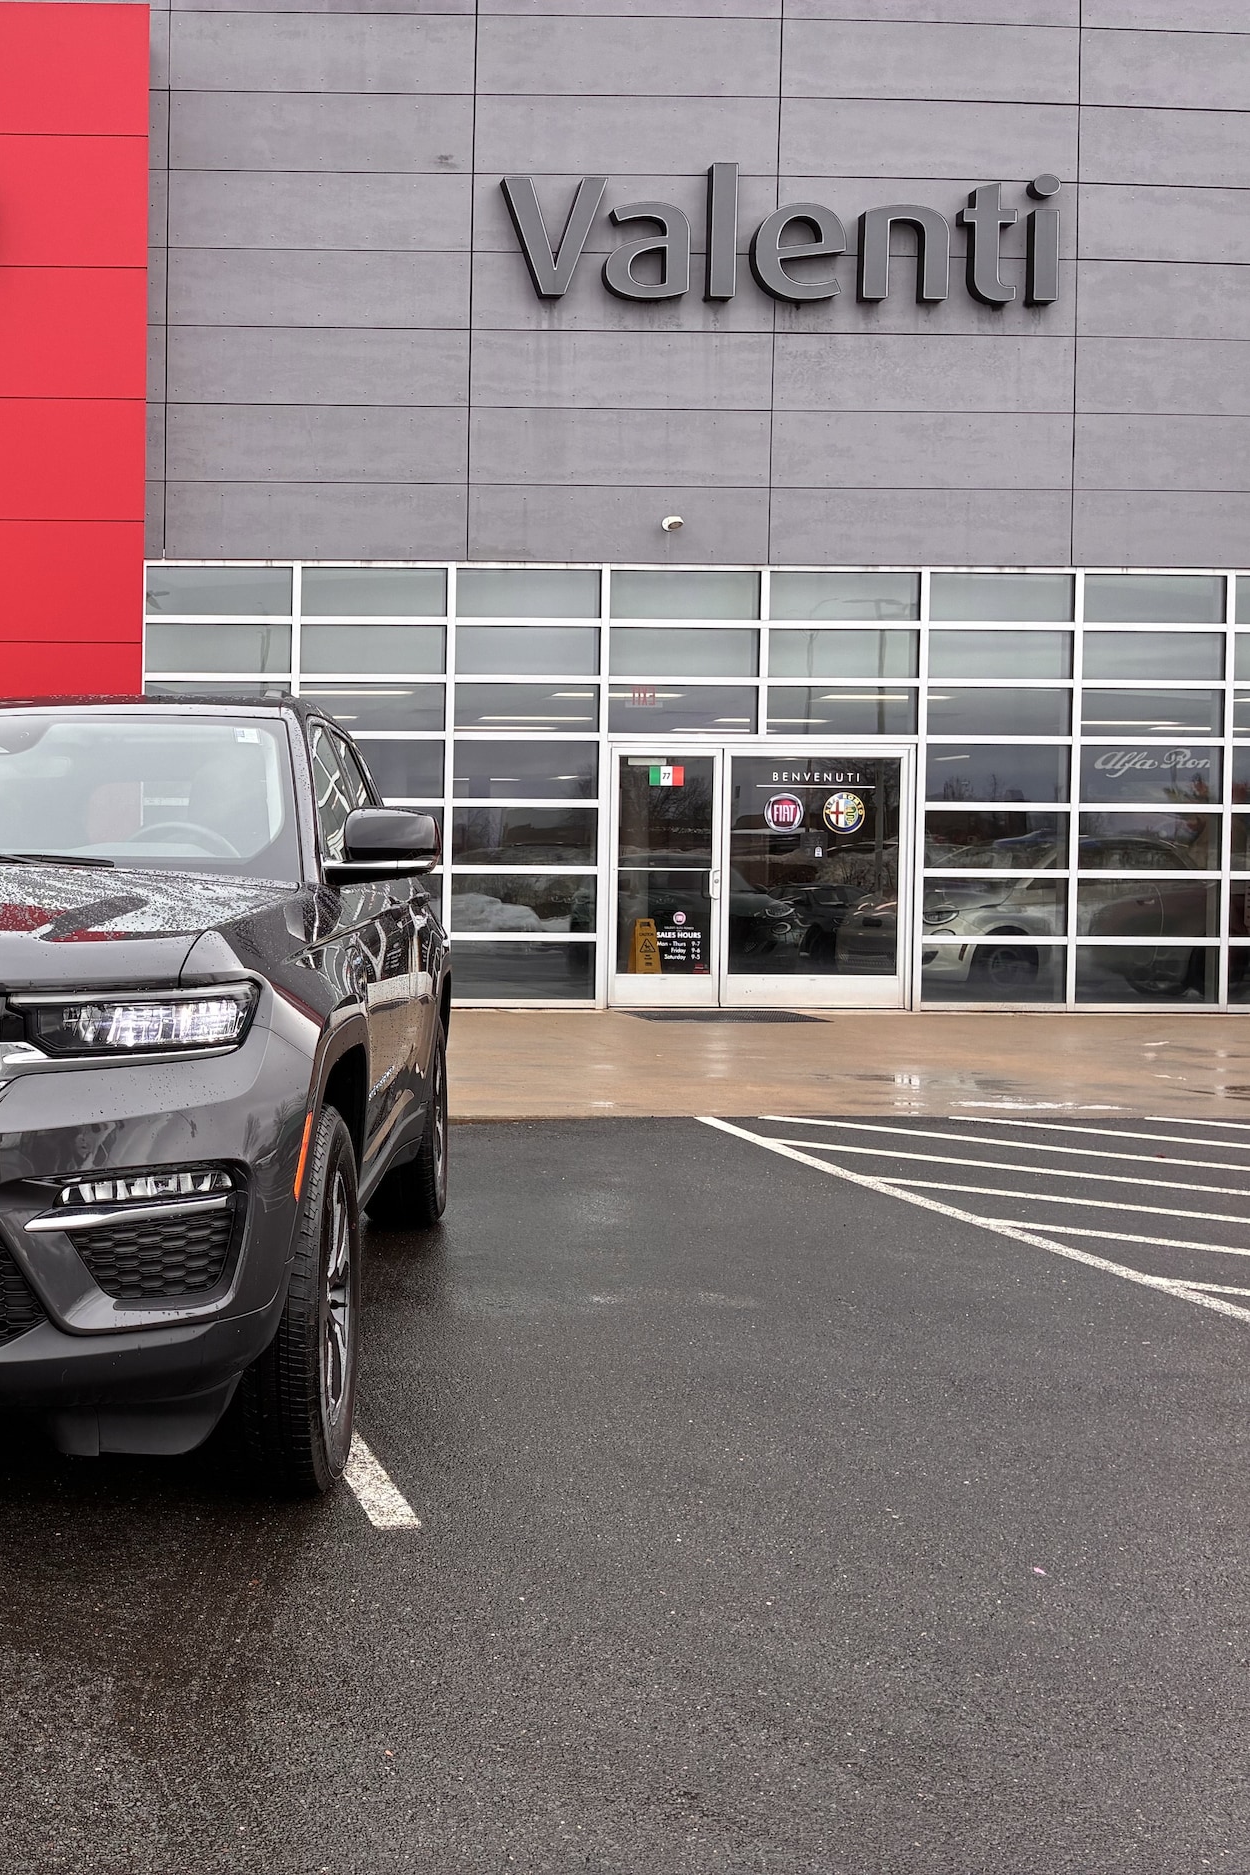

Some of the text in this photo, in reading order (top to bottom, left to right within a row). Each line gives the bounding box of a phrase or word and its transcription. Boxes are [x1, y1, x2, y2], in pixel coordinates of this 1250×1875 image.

[500, 162, 1062, 304] Valenti
[1094, 751, 1159, 778] Alfa
[662, 772, 671, 780] 77
[772, 772, 860, 782] BENVENUTI
[773, 804, 796, 822] FIAT
